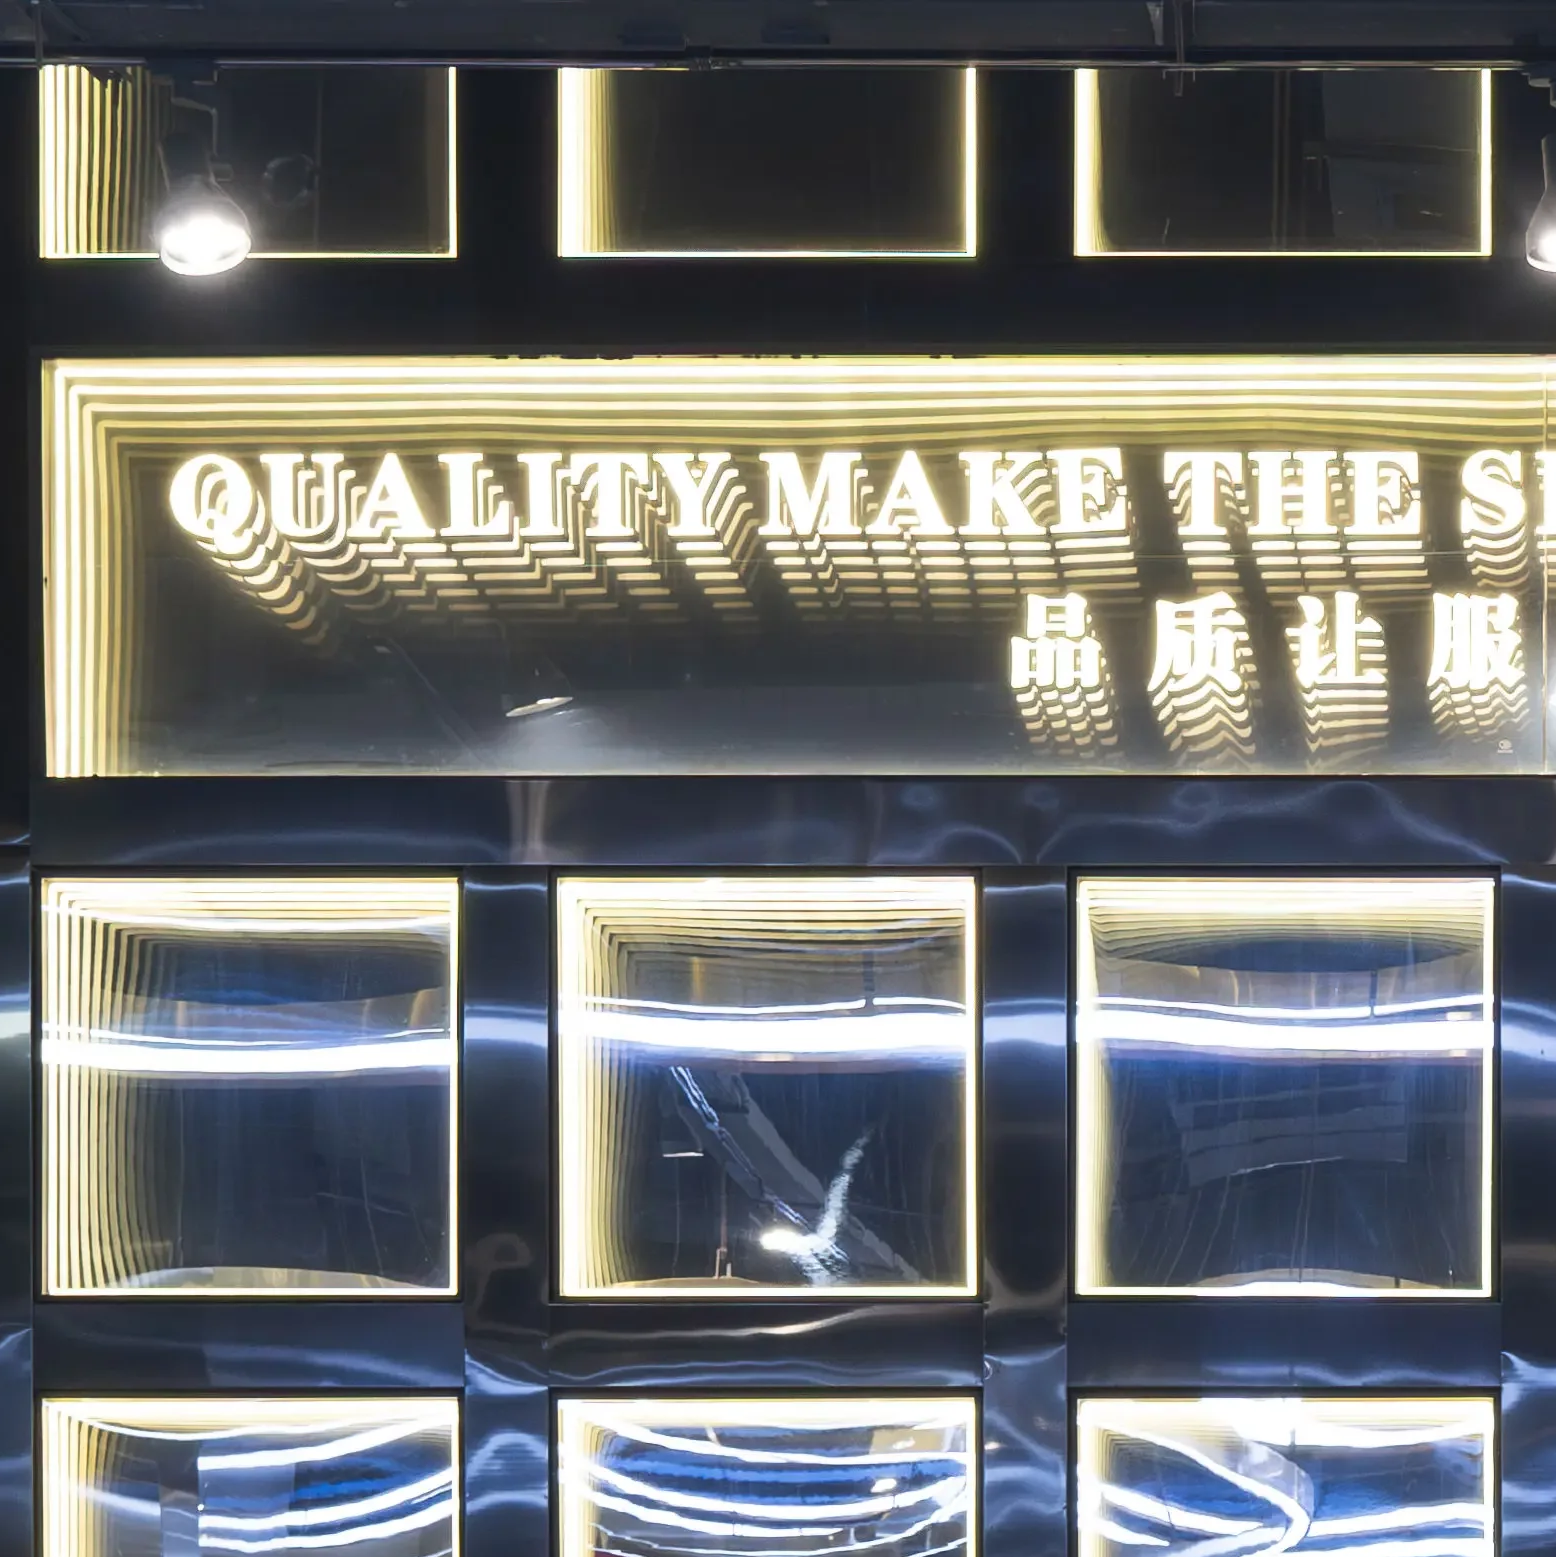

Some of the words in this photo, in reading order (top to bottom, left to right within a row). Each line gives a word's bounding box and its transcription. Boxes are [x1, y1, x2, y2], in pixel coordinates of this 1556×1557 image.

[168, 449, 734, 556] QUALITY
[760, 447, 1126, 537] MAKE
[1162, 449, 1424, 537] THE
